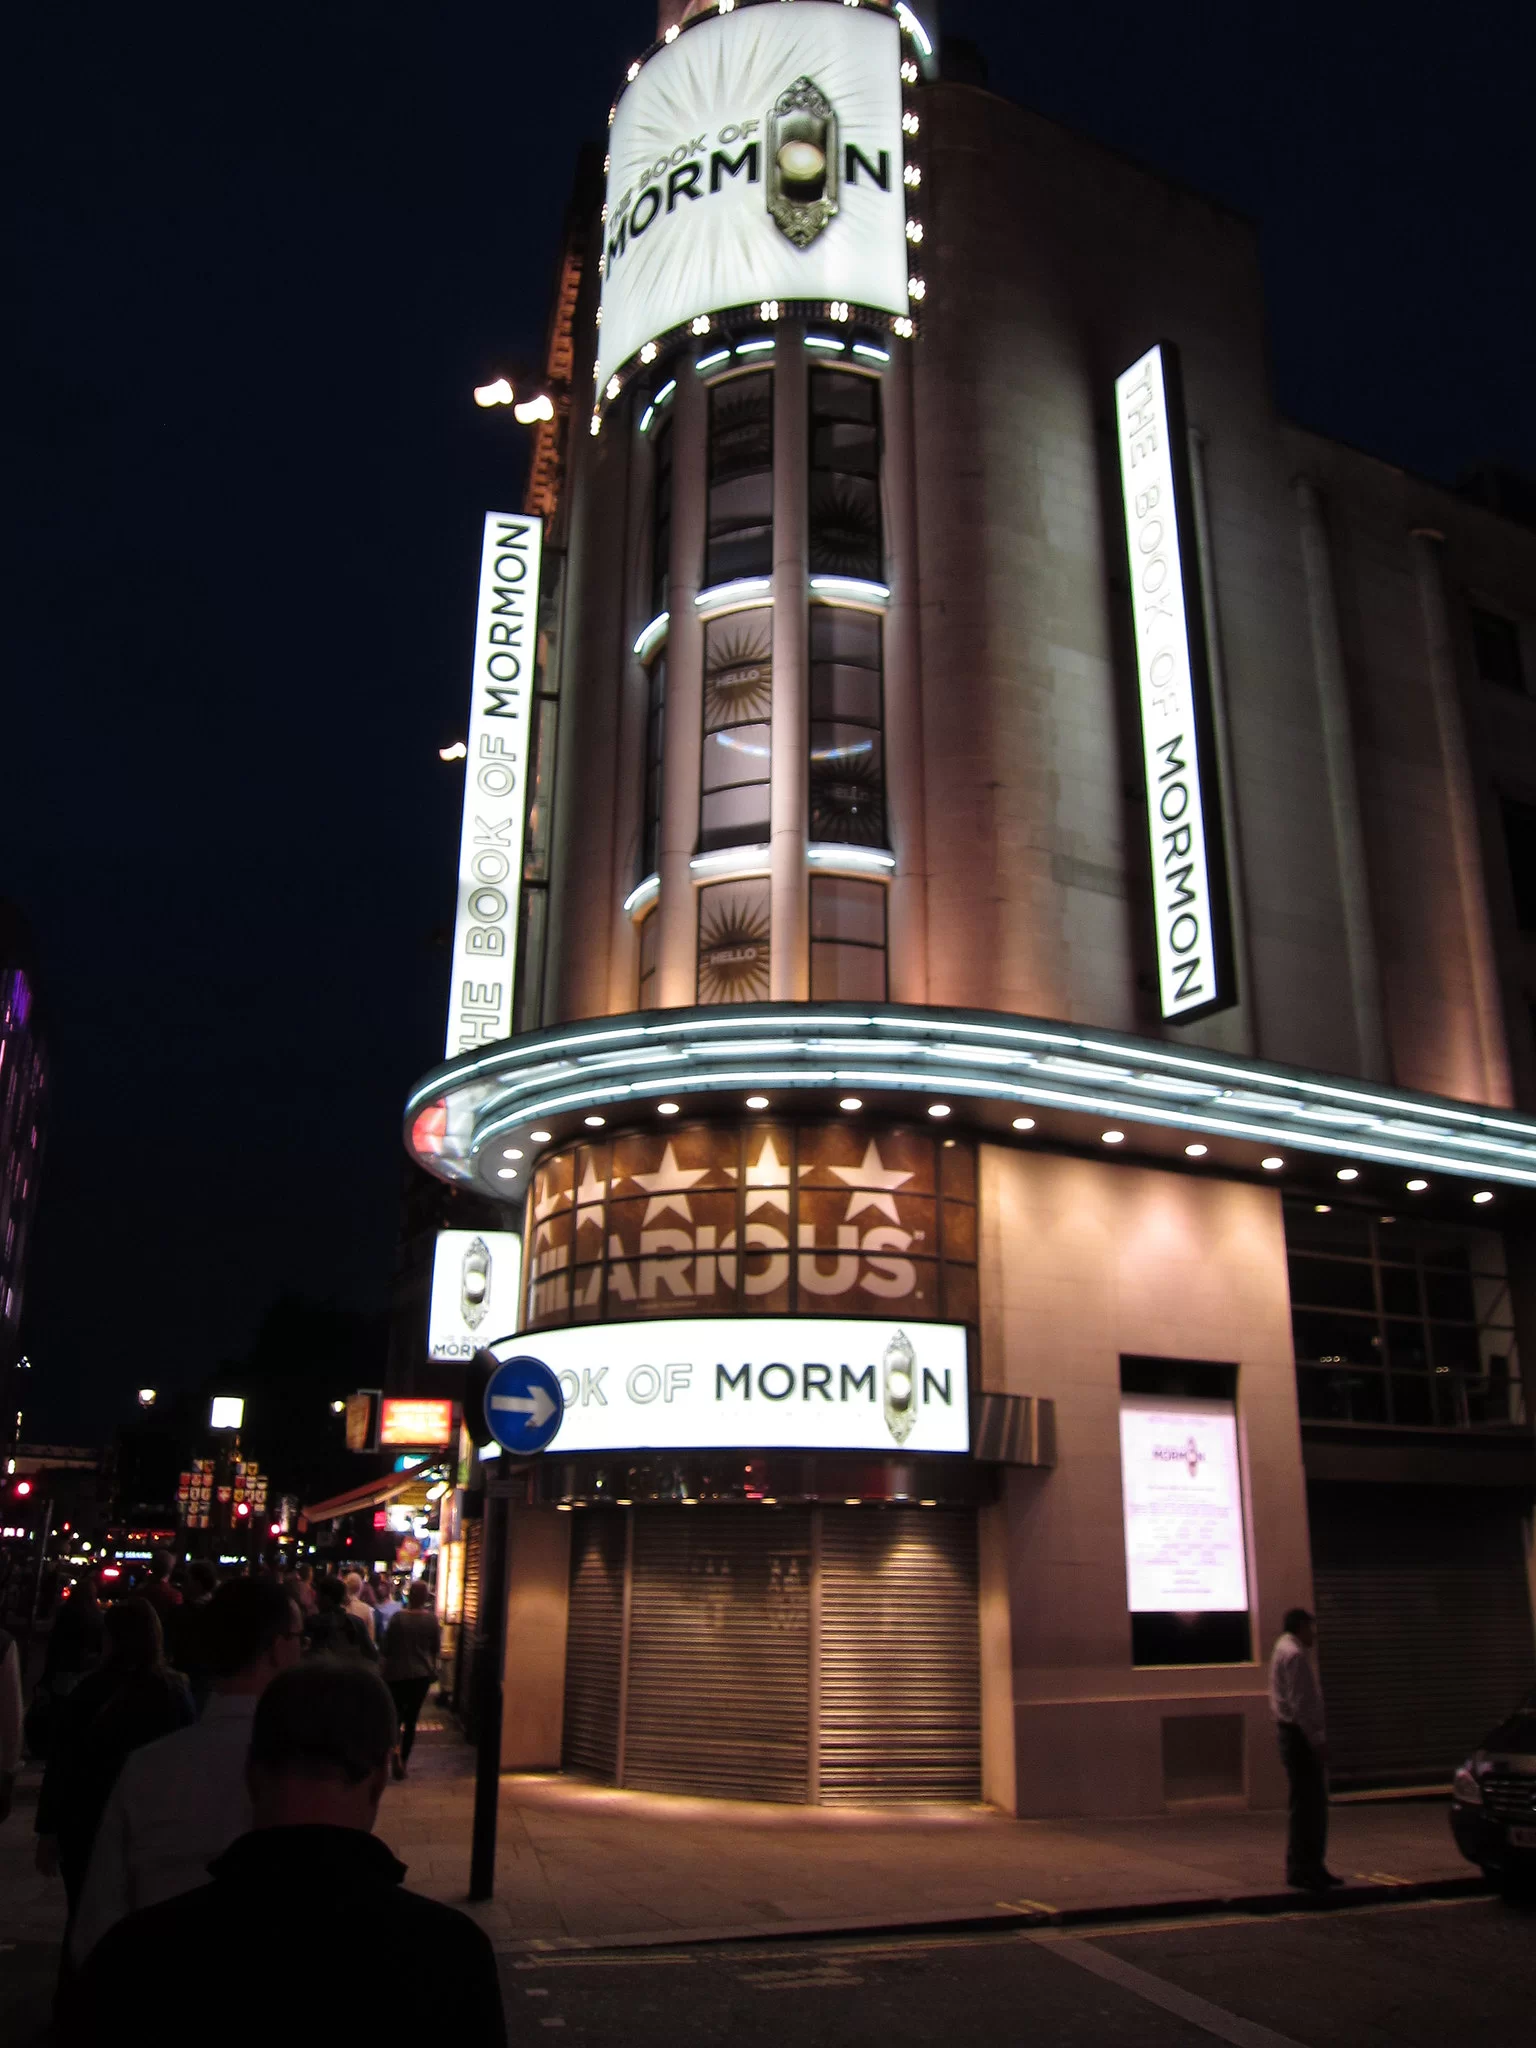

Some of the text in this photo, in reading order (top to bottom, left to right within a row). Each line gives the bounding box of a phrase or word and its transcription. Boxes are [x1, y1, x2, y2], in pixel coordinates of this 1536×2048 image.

[639, 133, 708, 191] BOOK
[718, 119, 761, 144] OF
[715, 670, 760, 689] HELLO
[1126, 361, 1204, 1003] THE BOOK OF MORMON
[458, 520, 531, 1054] HE BOOK OF MORMON
[710, 948, 757, 964] HELLO
[557, 1367, 609, 1409] OK
[626, 1363, 693, 1405] OF
